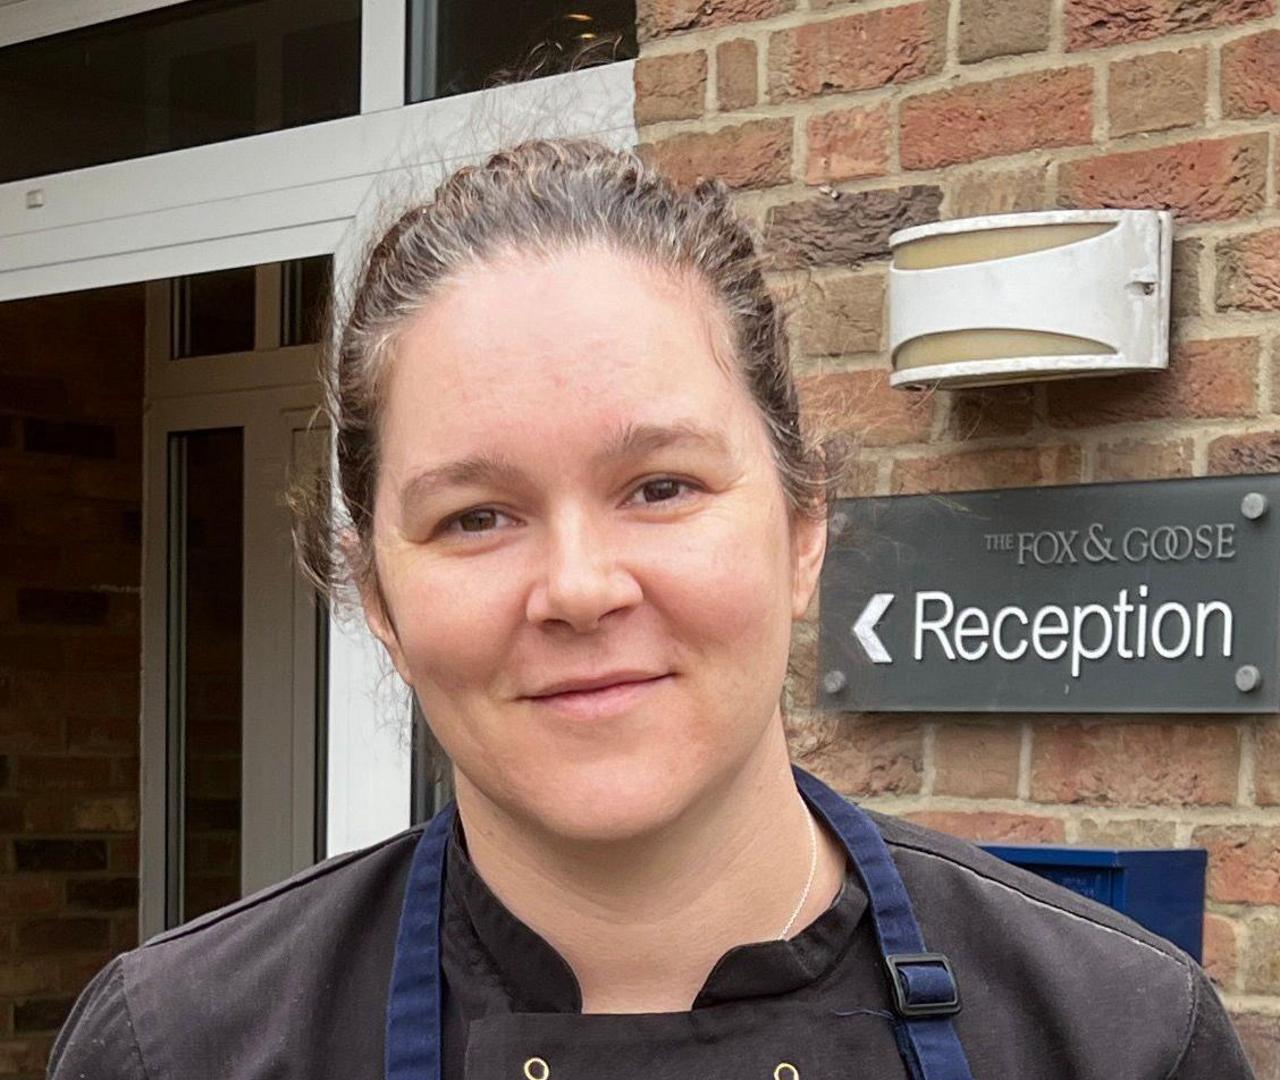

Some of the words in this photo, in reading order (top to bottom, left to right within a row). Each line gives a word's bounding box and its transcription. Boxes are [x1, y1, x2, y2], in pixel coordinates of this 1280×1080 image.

[984, 533, 1015, 551] THE
[1017, 530, 1079, 565] FOX
[1083, 523, 1118, 562] &
[1123, 523, 1236, 562] GOOSE
[914, 585, 1233, 678] Reception
